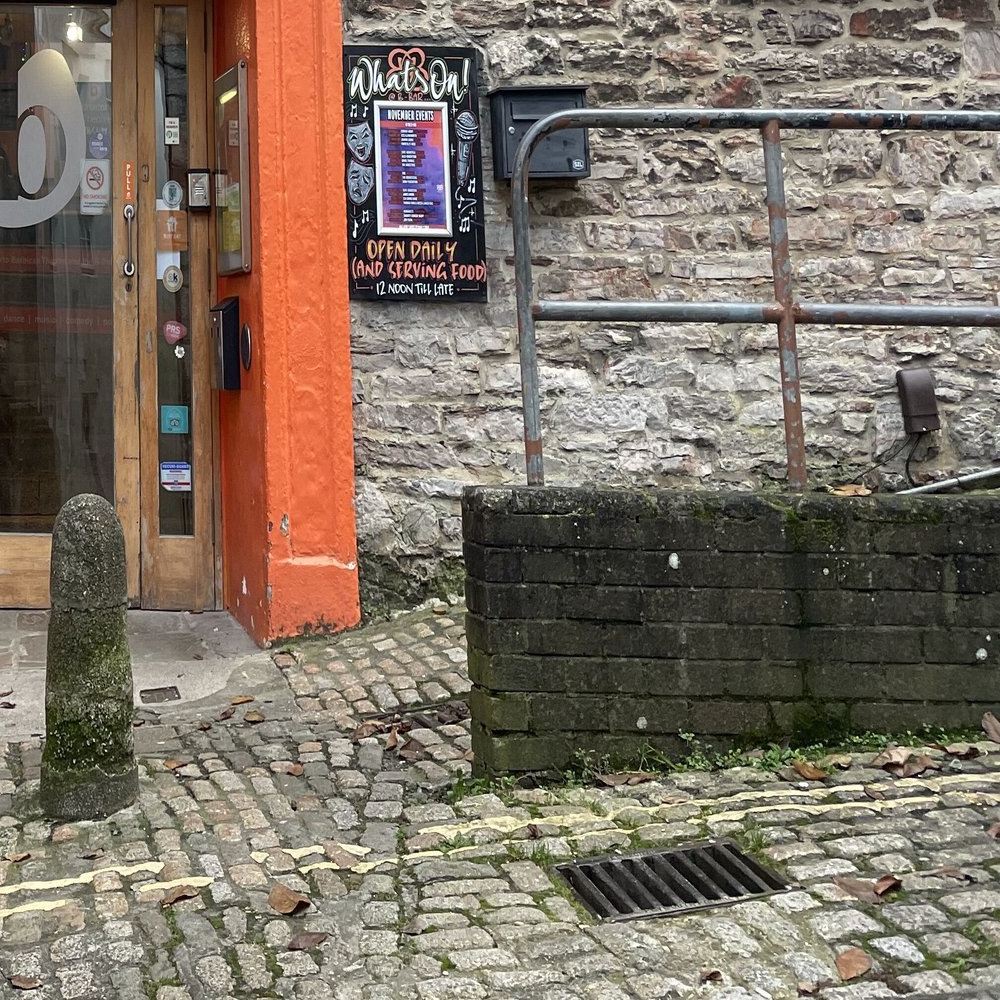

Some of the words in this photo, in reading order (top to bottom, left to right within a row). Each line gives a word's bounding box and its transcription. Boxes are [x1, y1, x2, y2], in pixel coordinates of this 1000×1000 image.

[416, 110, 434, 121] EVENTS
[366, 239, 405, 260] OPEN
[352, 256, 383, 280] (AND
[450, 259, 487, 282] FOOD)
[376, 281, 386, 295] 12
[388, 283, 414, 295] NOON
[434, 283, 454, 296] LATE
[166, 324, 181, 335] PRS
